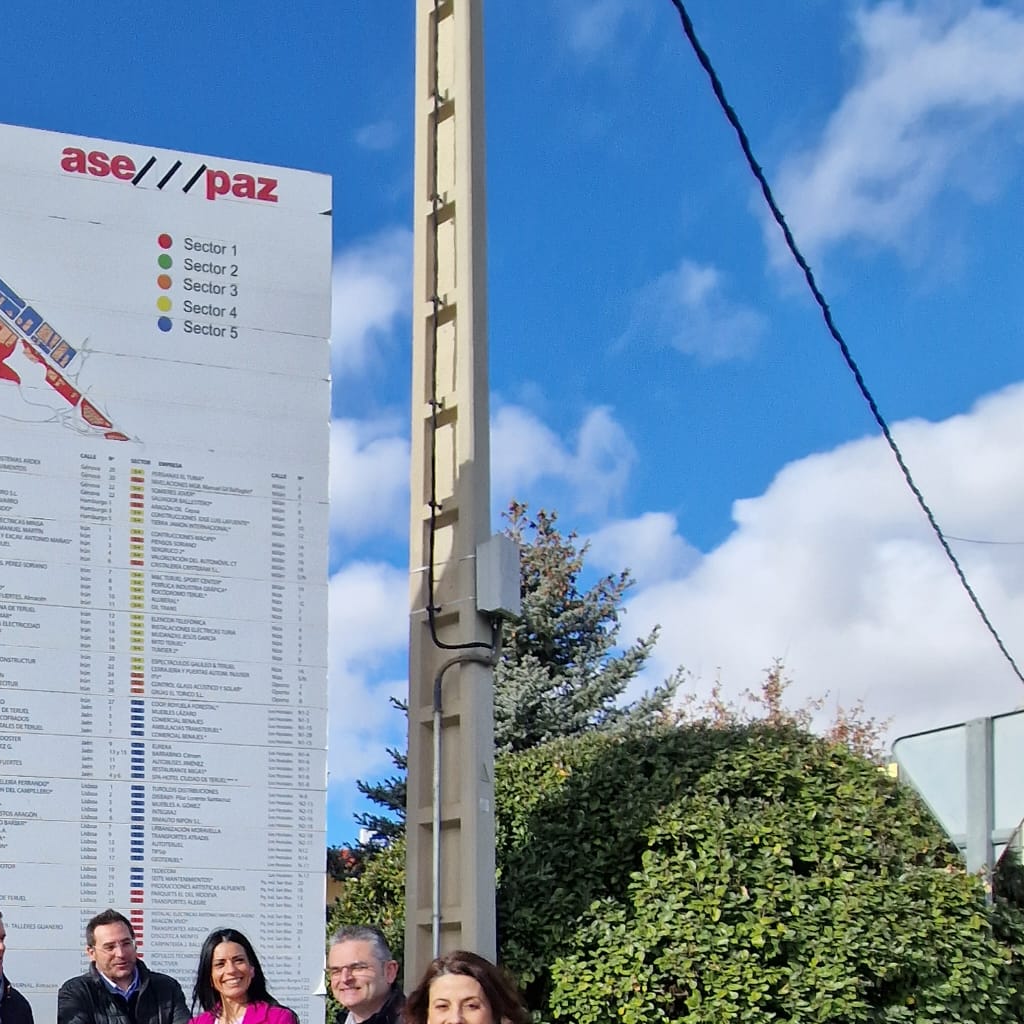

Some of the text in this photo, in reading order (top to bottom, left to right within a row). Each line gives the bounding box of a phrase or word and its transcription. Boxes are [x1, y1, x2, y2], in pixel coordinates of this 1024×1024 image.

[184, 238, 238, 256] Sector 1
[184, 258, 238, 277] Sector 2
[183, 278, 238, 297] Sector 3
[183, 300, 237, 318] Sector 4
[183, 320, 238, 339] Sector 5
